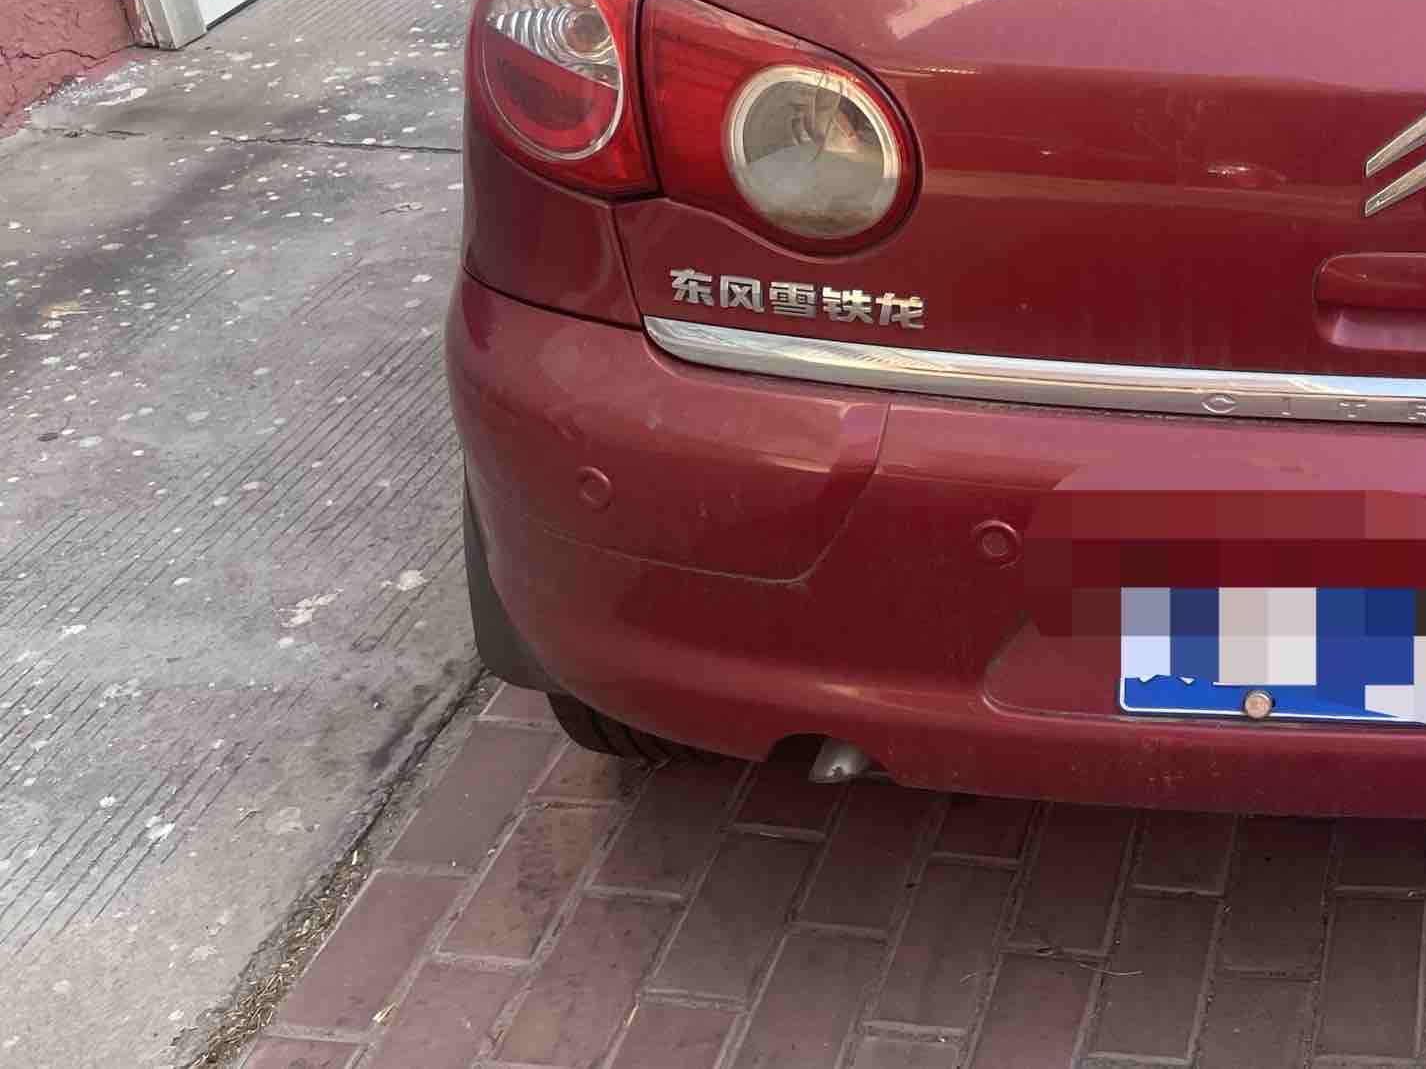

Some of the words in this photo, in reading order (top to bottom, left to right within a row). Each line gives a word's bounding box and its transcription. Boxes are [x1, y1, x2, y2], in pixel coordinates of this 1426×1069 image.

[670, 267, 926, 329] 东风雪铁龙
